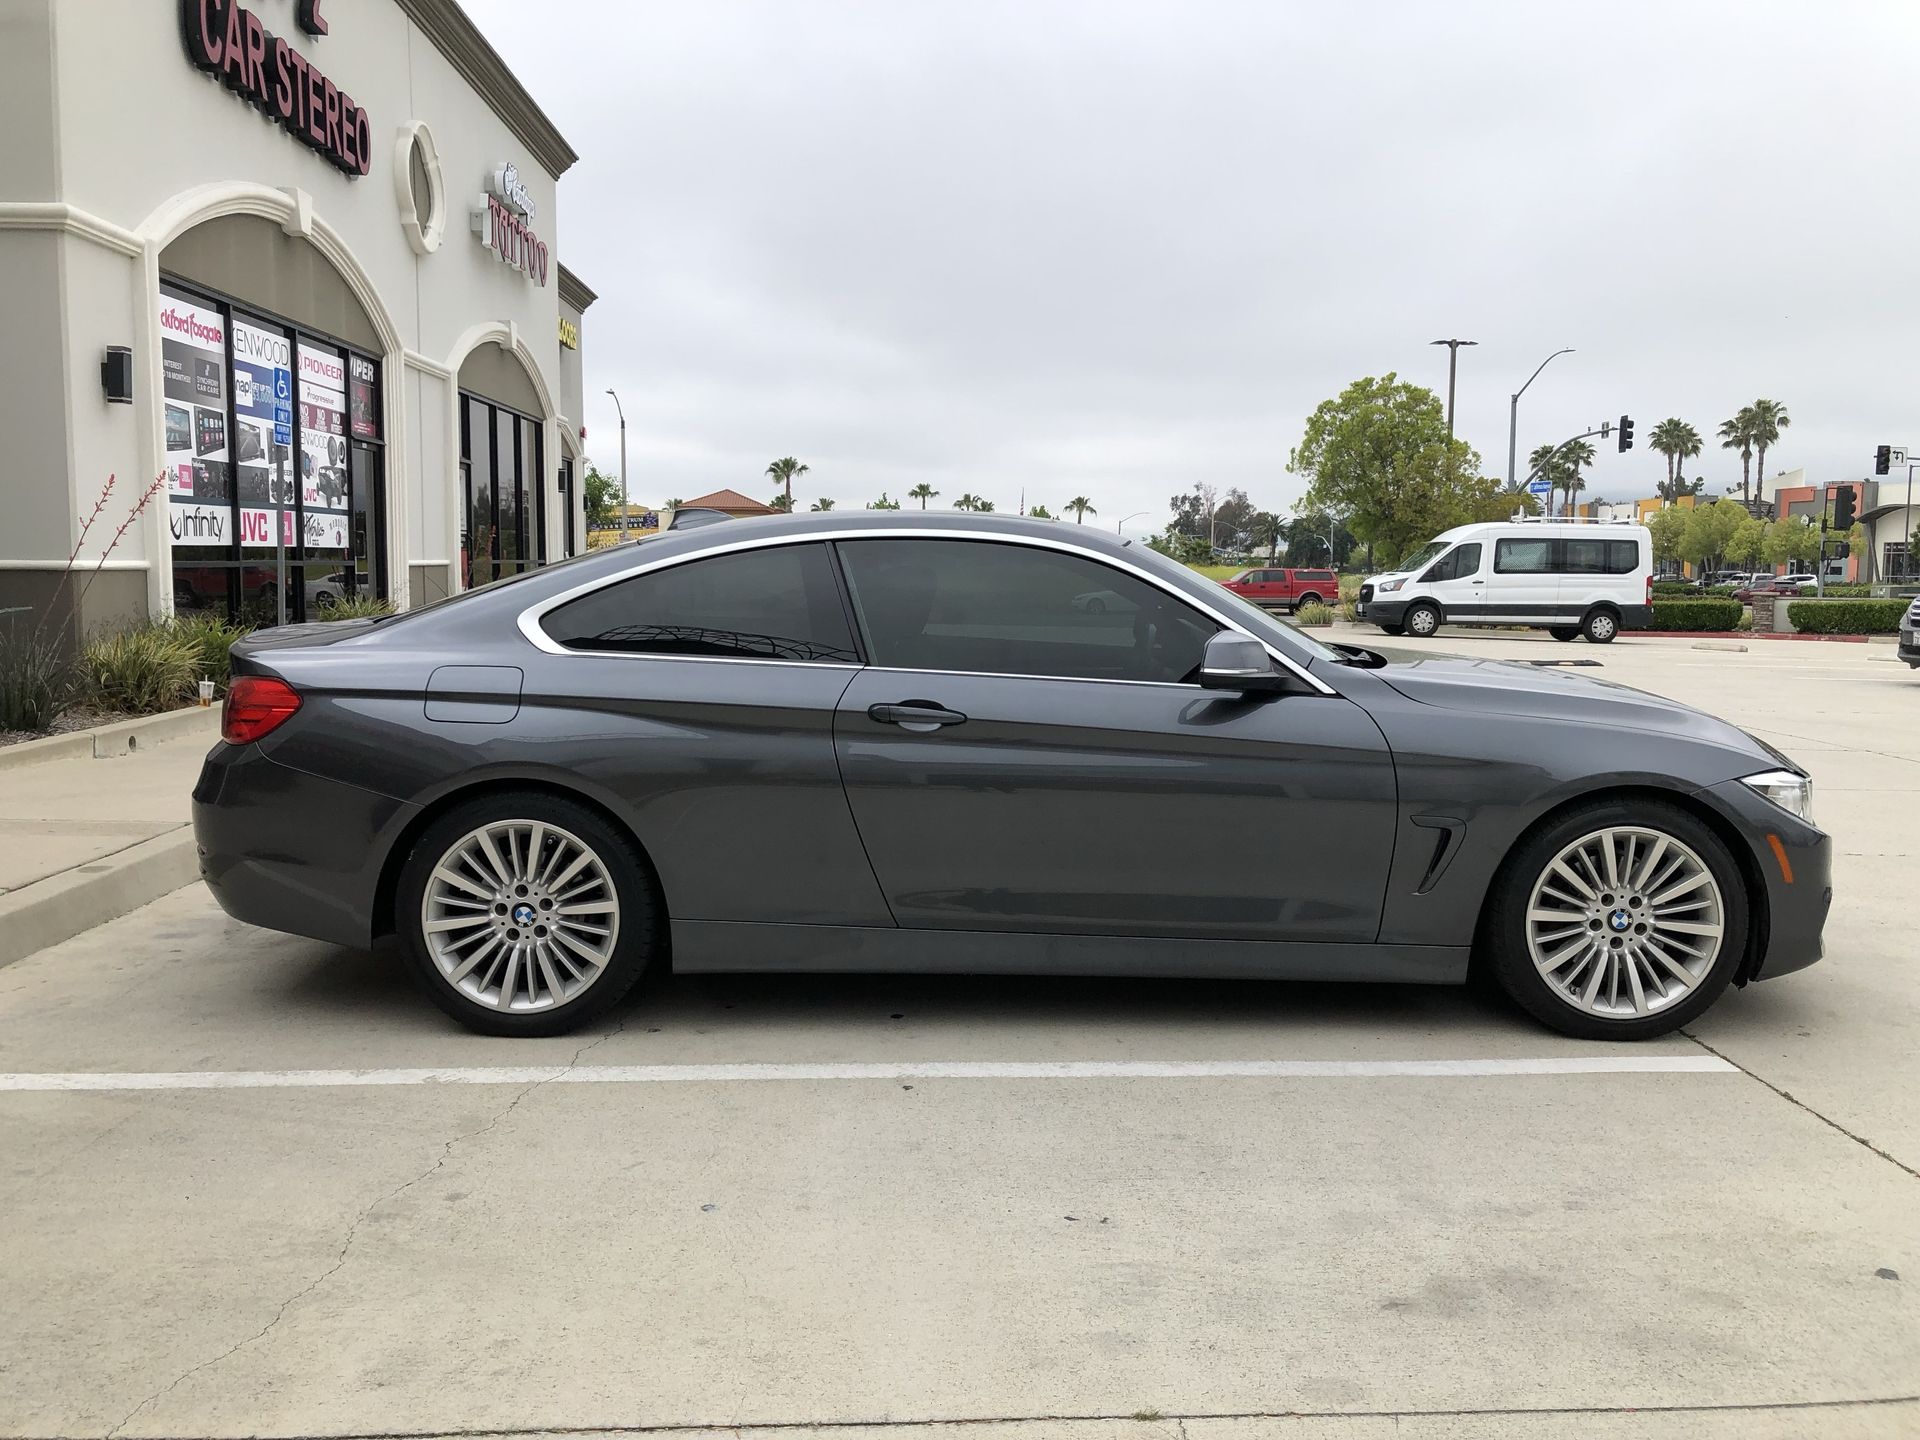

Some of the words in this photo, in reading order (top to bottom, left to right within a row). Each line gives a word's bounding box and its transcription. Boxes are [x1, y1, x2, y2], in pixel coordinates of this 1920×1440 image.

[200, 0, 268, 101] CAR
[276, 37, 371, 176] STEREO
[488, 193, 548, 288] TATTOO
[304, 356, 342, 381] PIONEER
[197, 384, 207, 392] CAR
[207, 386, 219, 395] CARE
[182, 506, 224, 542] Infinity
[241, 511, 268, 542] JVC
